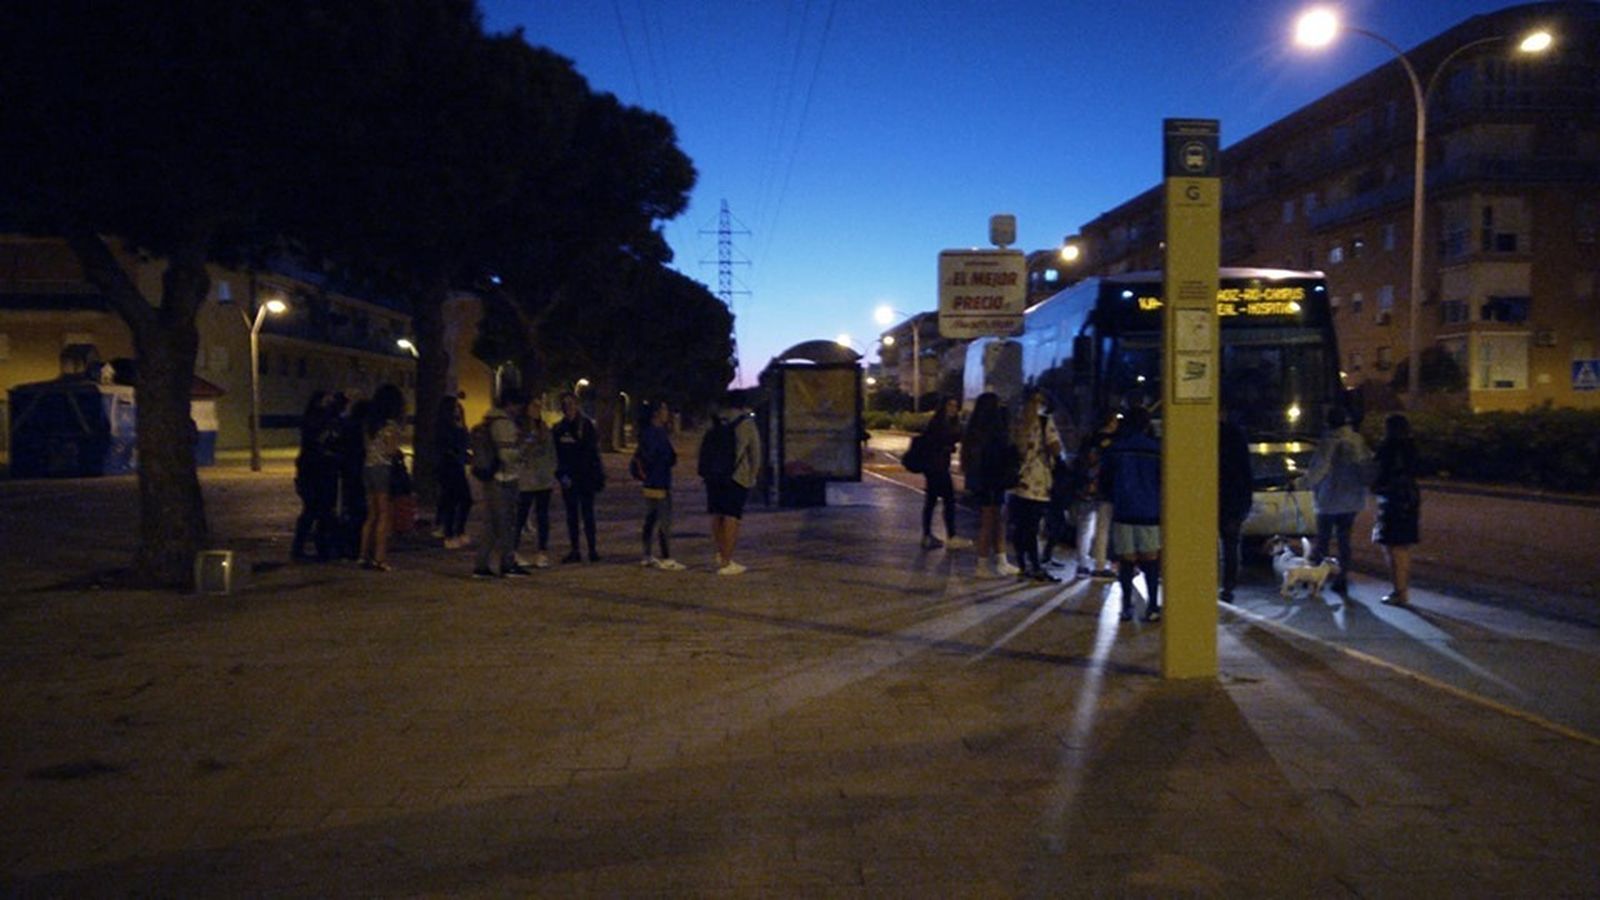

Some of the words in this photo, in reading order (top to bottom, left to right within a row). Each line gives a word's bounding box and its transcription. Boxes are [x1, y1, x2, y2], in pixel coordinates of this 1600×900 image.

[1186, 186, 1201, 201] G
[953, 271, 967, 286] EL
[971, 271, 1018, 287] MEJOR
[953, 295, 1004, 310] PRECIO
